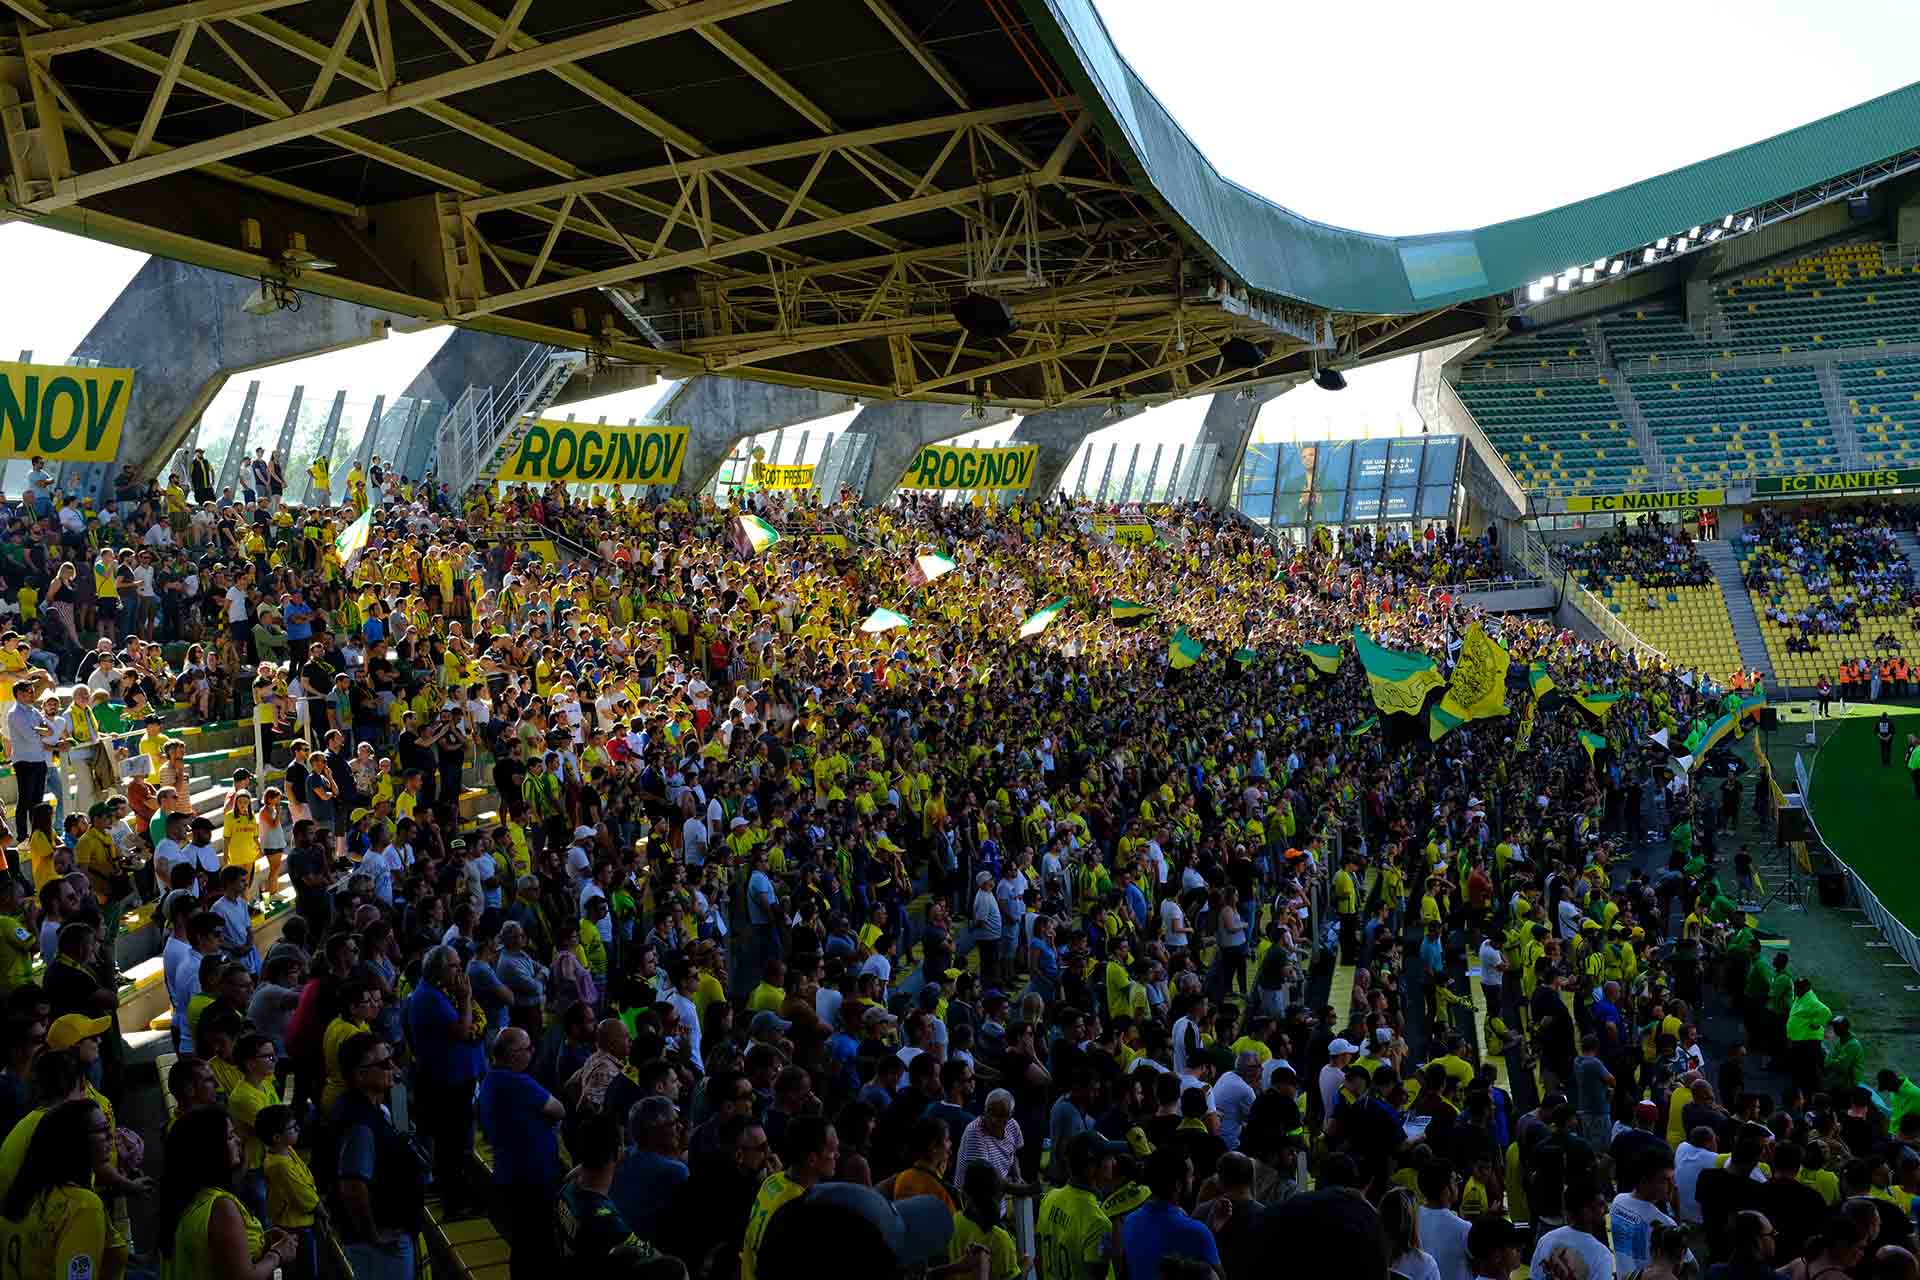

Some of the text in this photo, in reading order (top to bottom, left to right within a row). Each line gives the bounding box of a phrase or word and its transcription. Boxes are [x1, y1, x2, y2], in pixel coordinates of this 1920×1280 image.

[0, 373, 124, 453] NOV
[1781, 472, 1899, 492] FC NANTES
[1591, 491, 1699, 510] FC NANTES
